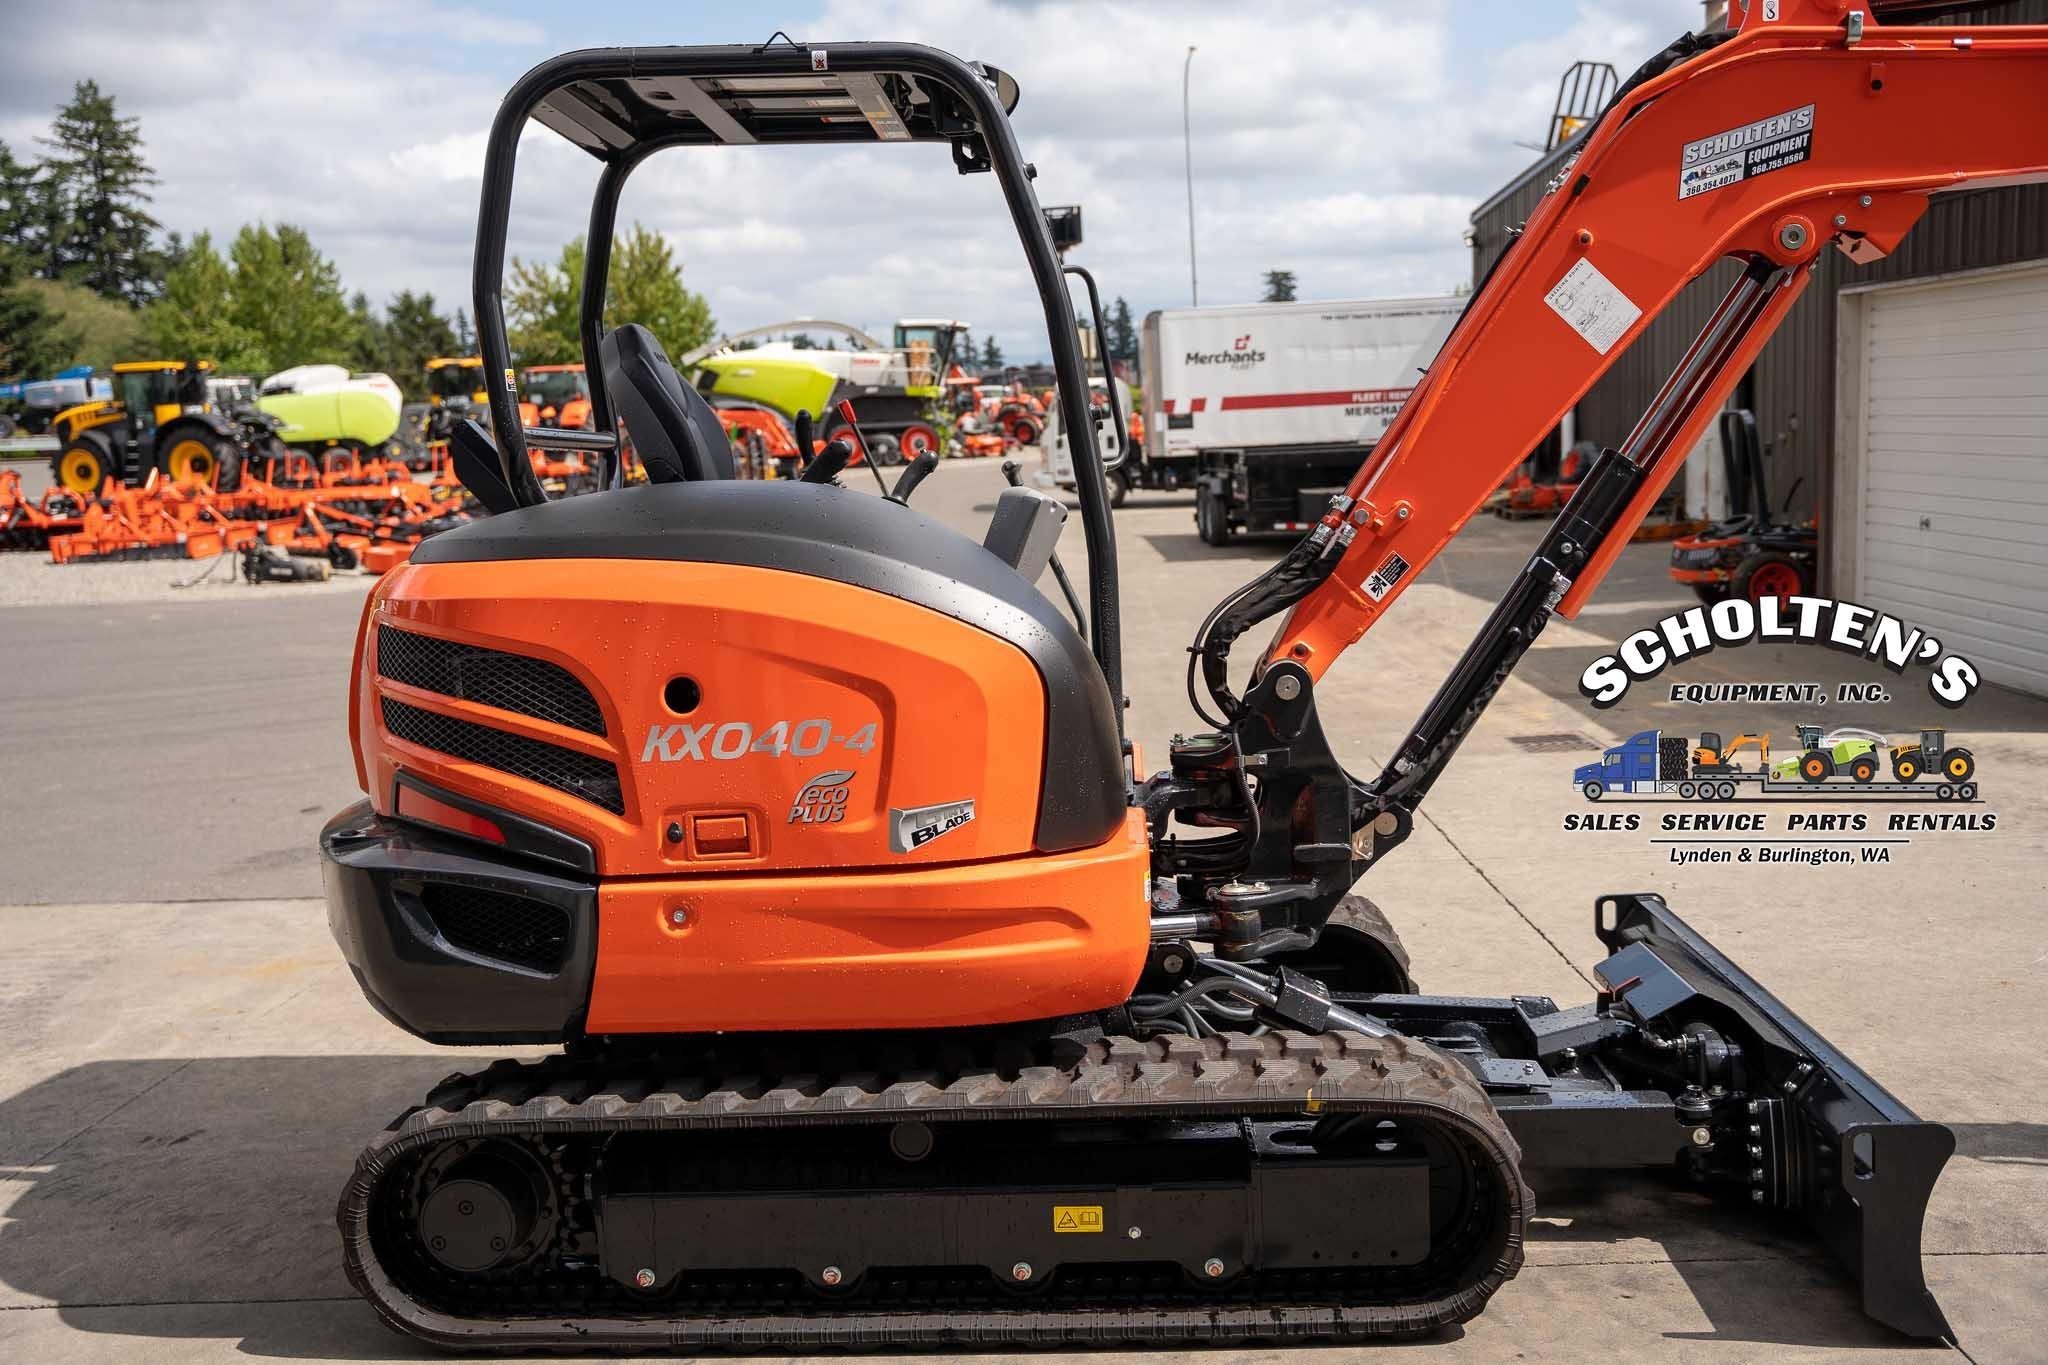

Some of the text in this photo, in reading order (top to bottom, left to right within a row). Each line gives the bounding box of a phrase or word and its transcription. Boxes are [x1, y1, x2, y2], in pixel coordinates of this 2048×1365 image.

[1686, 109, 1810, 164] SCHOLTEN'S
[1748, 133, 1810, 164] EQUIPMENT
[1686, 174, 1736, 196] 360.354.4071
[1185, 349, 1265, 366] Merchants
[1345, 405, 1402, 416] MERCHA
[641, 717, 877, 762] KX040-4
[804, 786, 850, 805] eco
[787, 804, 847, 824] PLUS
[911, 811, 971, 847] BLADE
